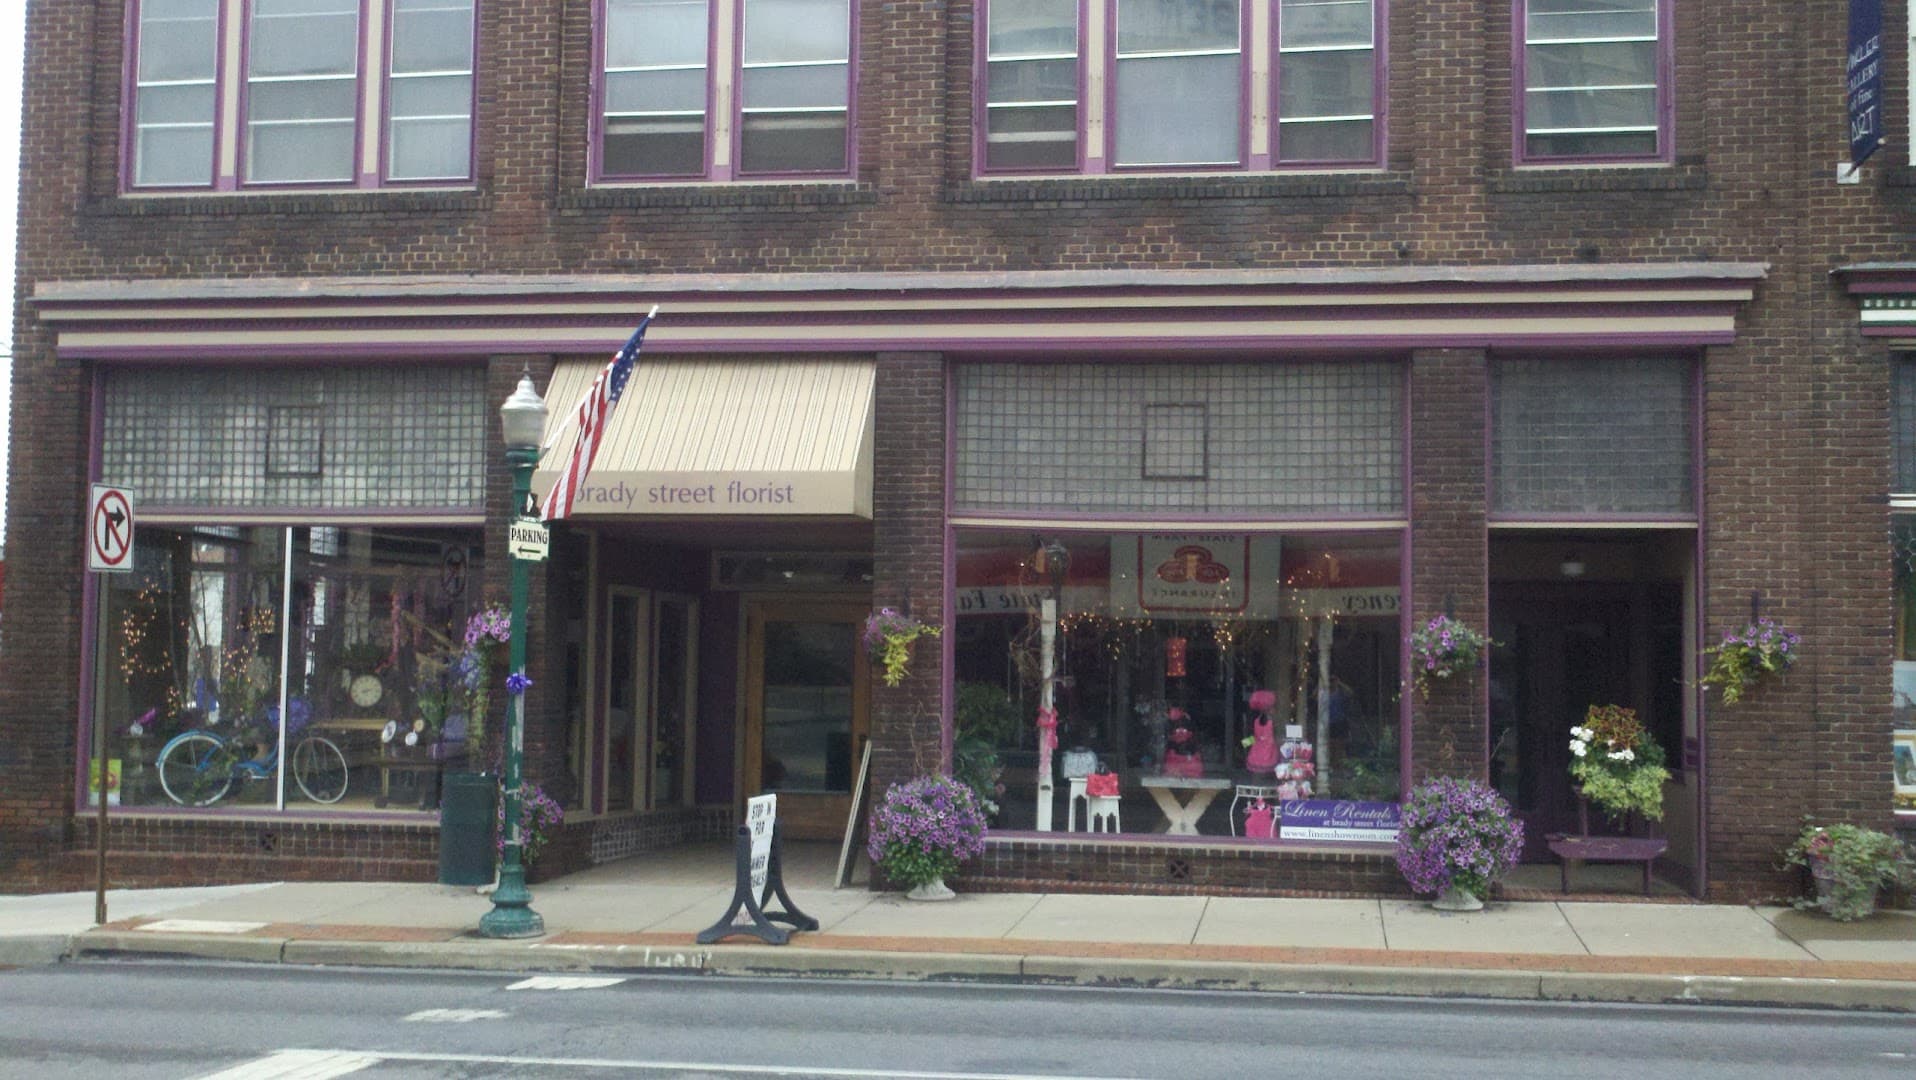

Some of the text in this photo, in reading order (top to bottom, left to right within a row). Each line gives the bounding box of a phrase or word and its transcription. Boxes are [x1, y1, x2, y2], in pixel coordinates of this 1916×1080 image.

[1851, 105, 1875, 143] ART
[648, 484, 716, 503] street
[727, 480, 794, 503] florist
[511, 527, 548, 545] PARKING
[751, 803, 764, 820] STOP
[1284, 800, 1391, 819] Linen Rentals
[755, 821, 765, 836] FOR
